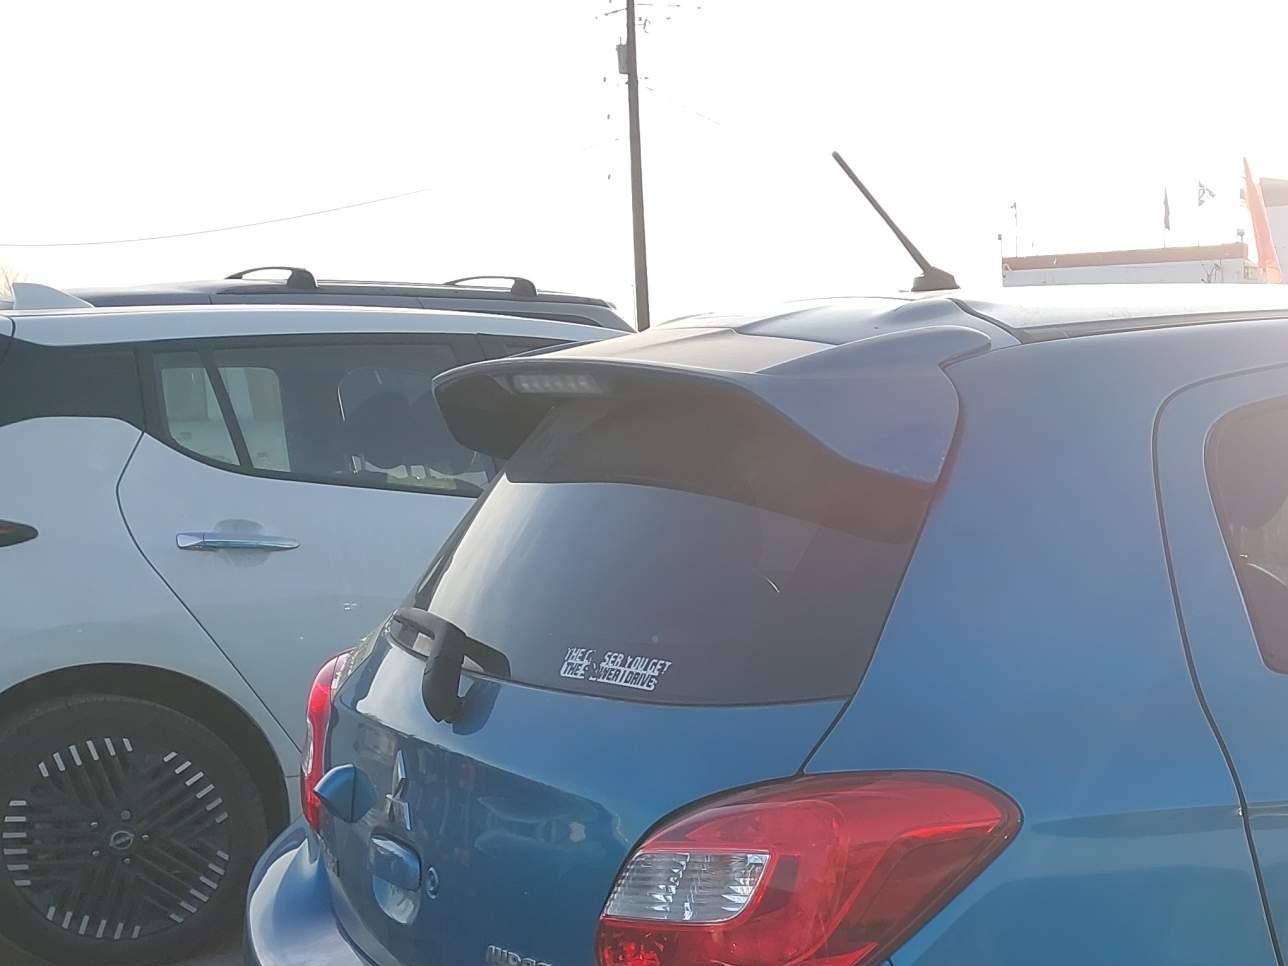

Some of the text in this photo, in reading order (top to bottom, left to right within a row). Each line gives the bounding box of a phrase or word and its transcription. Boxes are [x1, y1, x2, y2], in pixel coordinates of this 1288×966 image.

[565, 647, 672, 674] THE CSER YOU GET
[563, 661, 582, 676] THE
[624, 670, 655, 688] DRIVE
